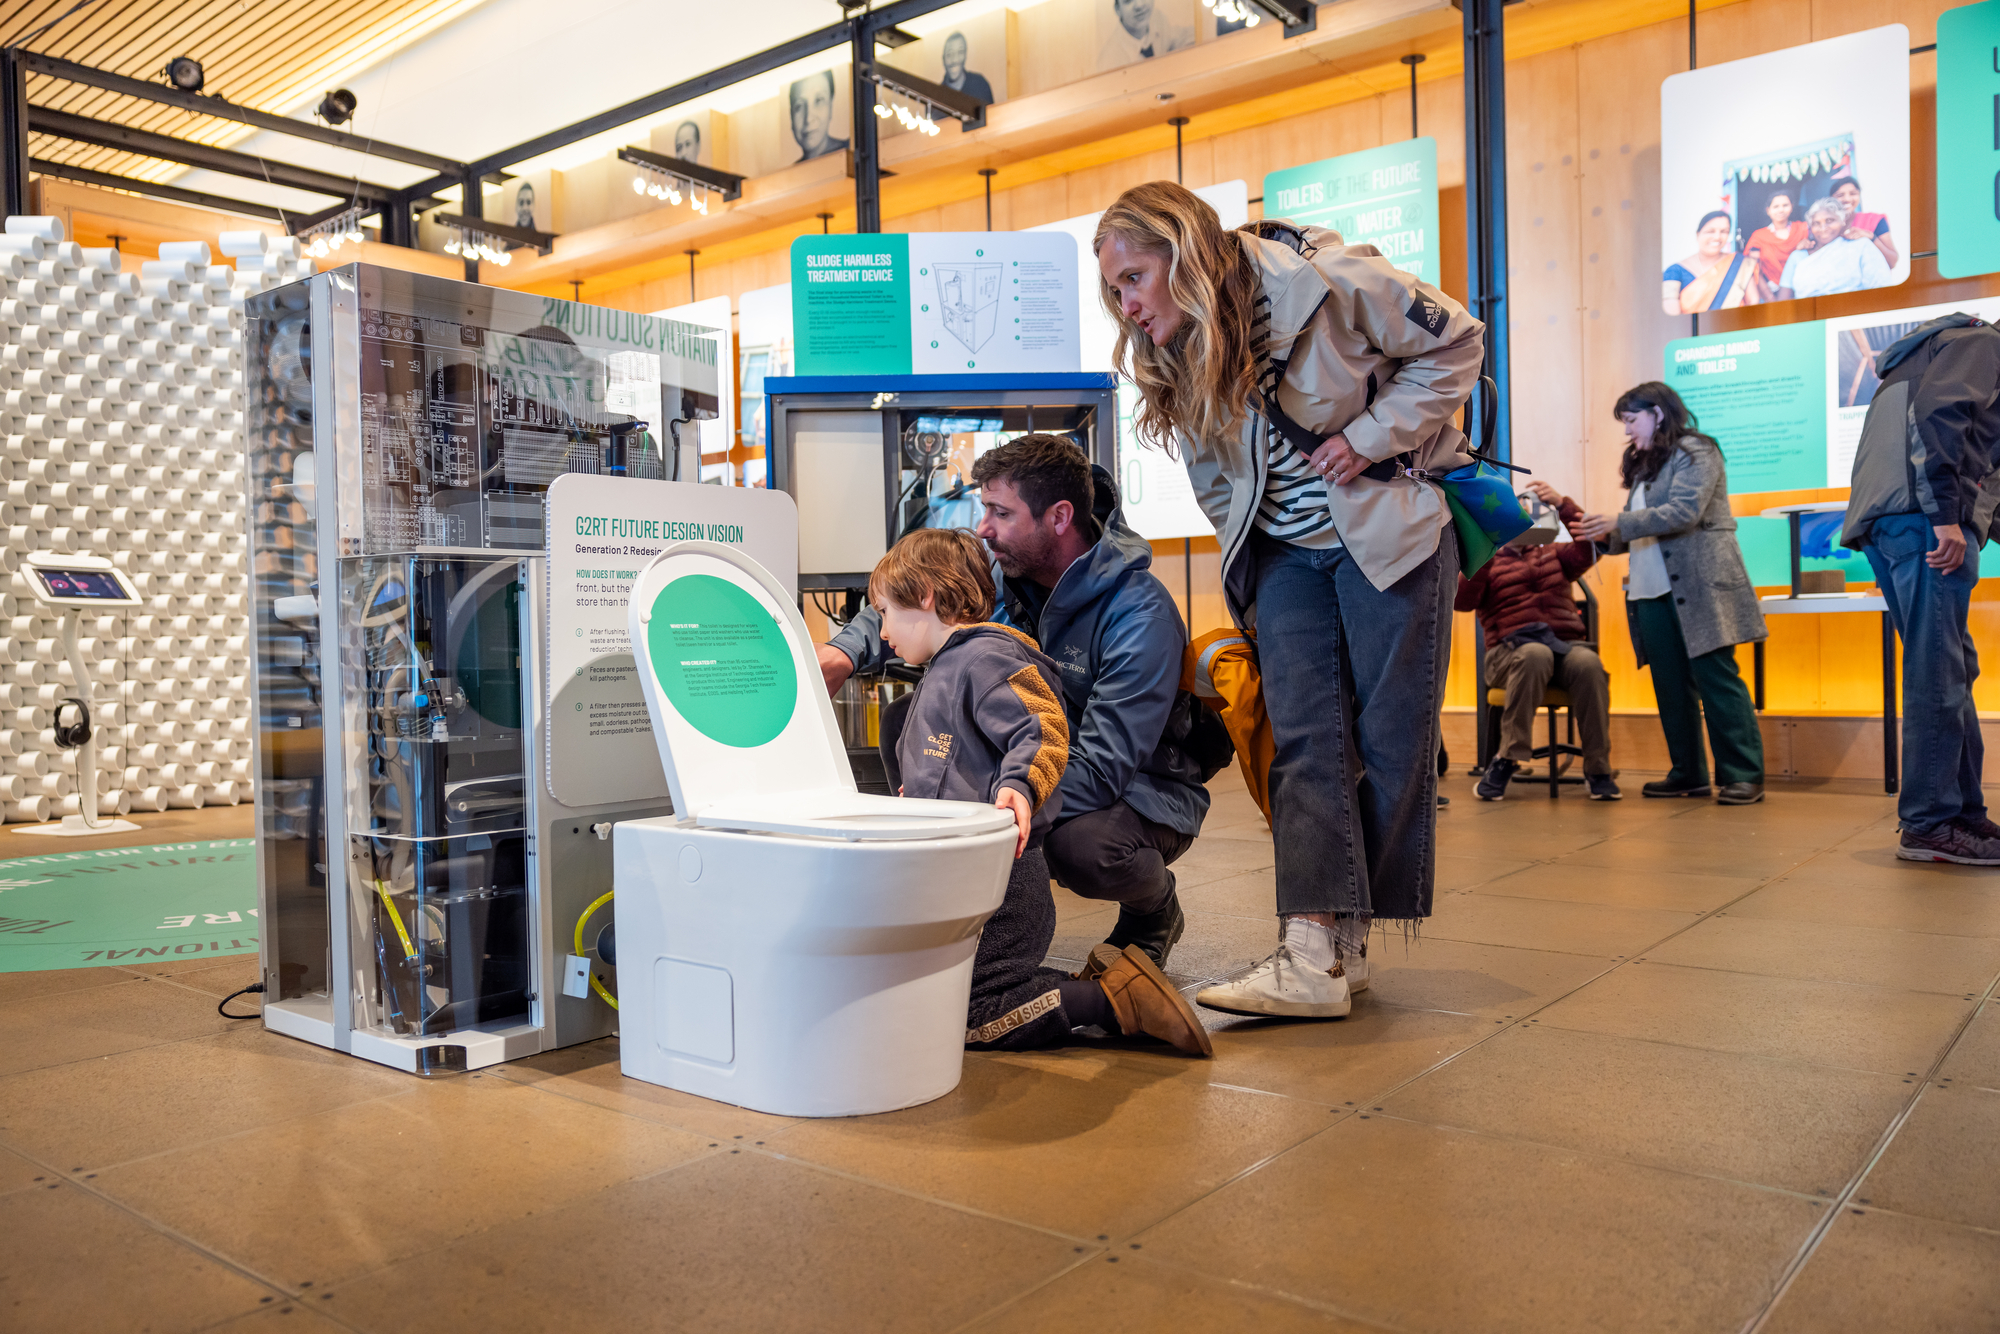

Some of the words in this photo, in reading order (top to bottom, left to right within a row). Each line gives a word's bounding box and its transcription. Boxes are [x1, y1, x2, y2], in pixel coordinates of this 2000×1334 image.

[1277, 182, 1323, 211] TOILETS
[1326, 178, 1341, 200] OF
[1346, 172, 1370, 195] THE
[1372, 160, 1421, 190] FUTURE
[1335, 215, 1354, 237] NO
[1356, 206, 1402, 235] WATER
[806, 255, 841, 267] SLUDGE
[843, 254, 892, 266] HARMLESS
[807, 270, 860, 282] TREATMENT
[862, 269, 893, 282] DEVICE
[1429, 303, 1442, 328] adidas
[1675, 344, 1725, 362] CHANGING
[1726, 340, 1760, 356] MINDS
[1675, 363, 1696, 376] AND
[1697, 358, 1737, 375] TOILETS
[576, 516, 607, 535] G2RT
[612, 518, 659, 539] FUTURE
[663, 521, 704, 541] DESIGN
[708, 524, 743, 543] VISION
[576, 544, 621, 554] Generation
[624, 546, 628, 555] 2
[576, 570, 591, 578] HOW
[592, 570, 608, 578] DOES
[610, 570, 615, 578] IT
[616, 570, 637, 579] WORK?
[576, 583, 599, 593] front,
[602, 584, 614, 592] but
[617, 584, 630, 592] the
[600, 598, 618, 606] than
[928, 735, 952, 748] CLOSE
[939, 733, 953, 742] GET
[938, 745, 949, 753] TO
[96, 848, 142, 857] OR
[38, 853, 252, 878] FUTURE
[982, 1012, 1020, 1041] SISLEY
[1022, 992, 1060, 1019] SISLEY
